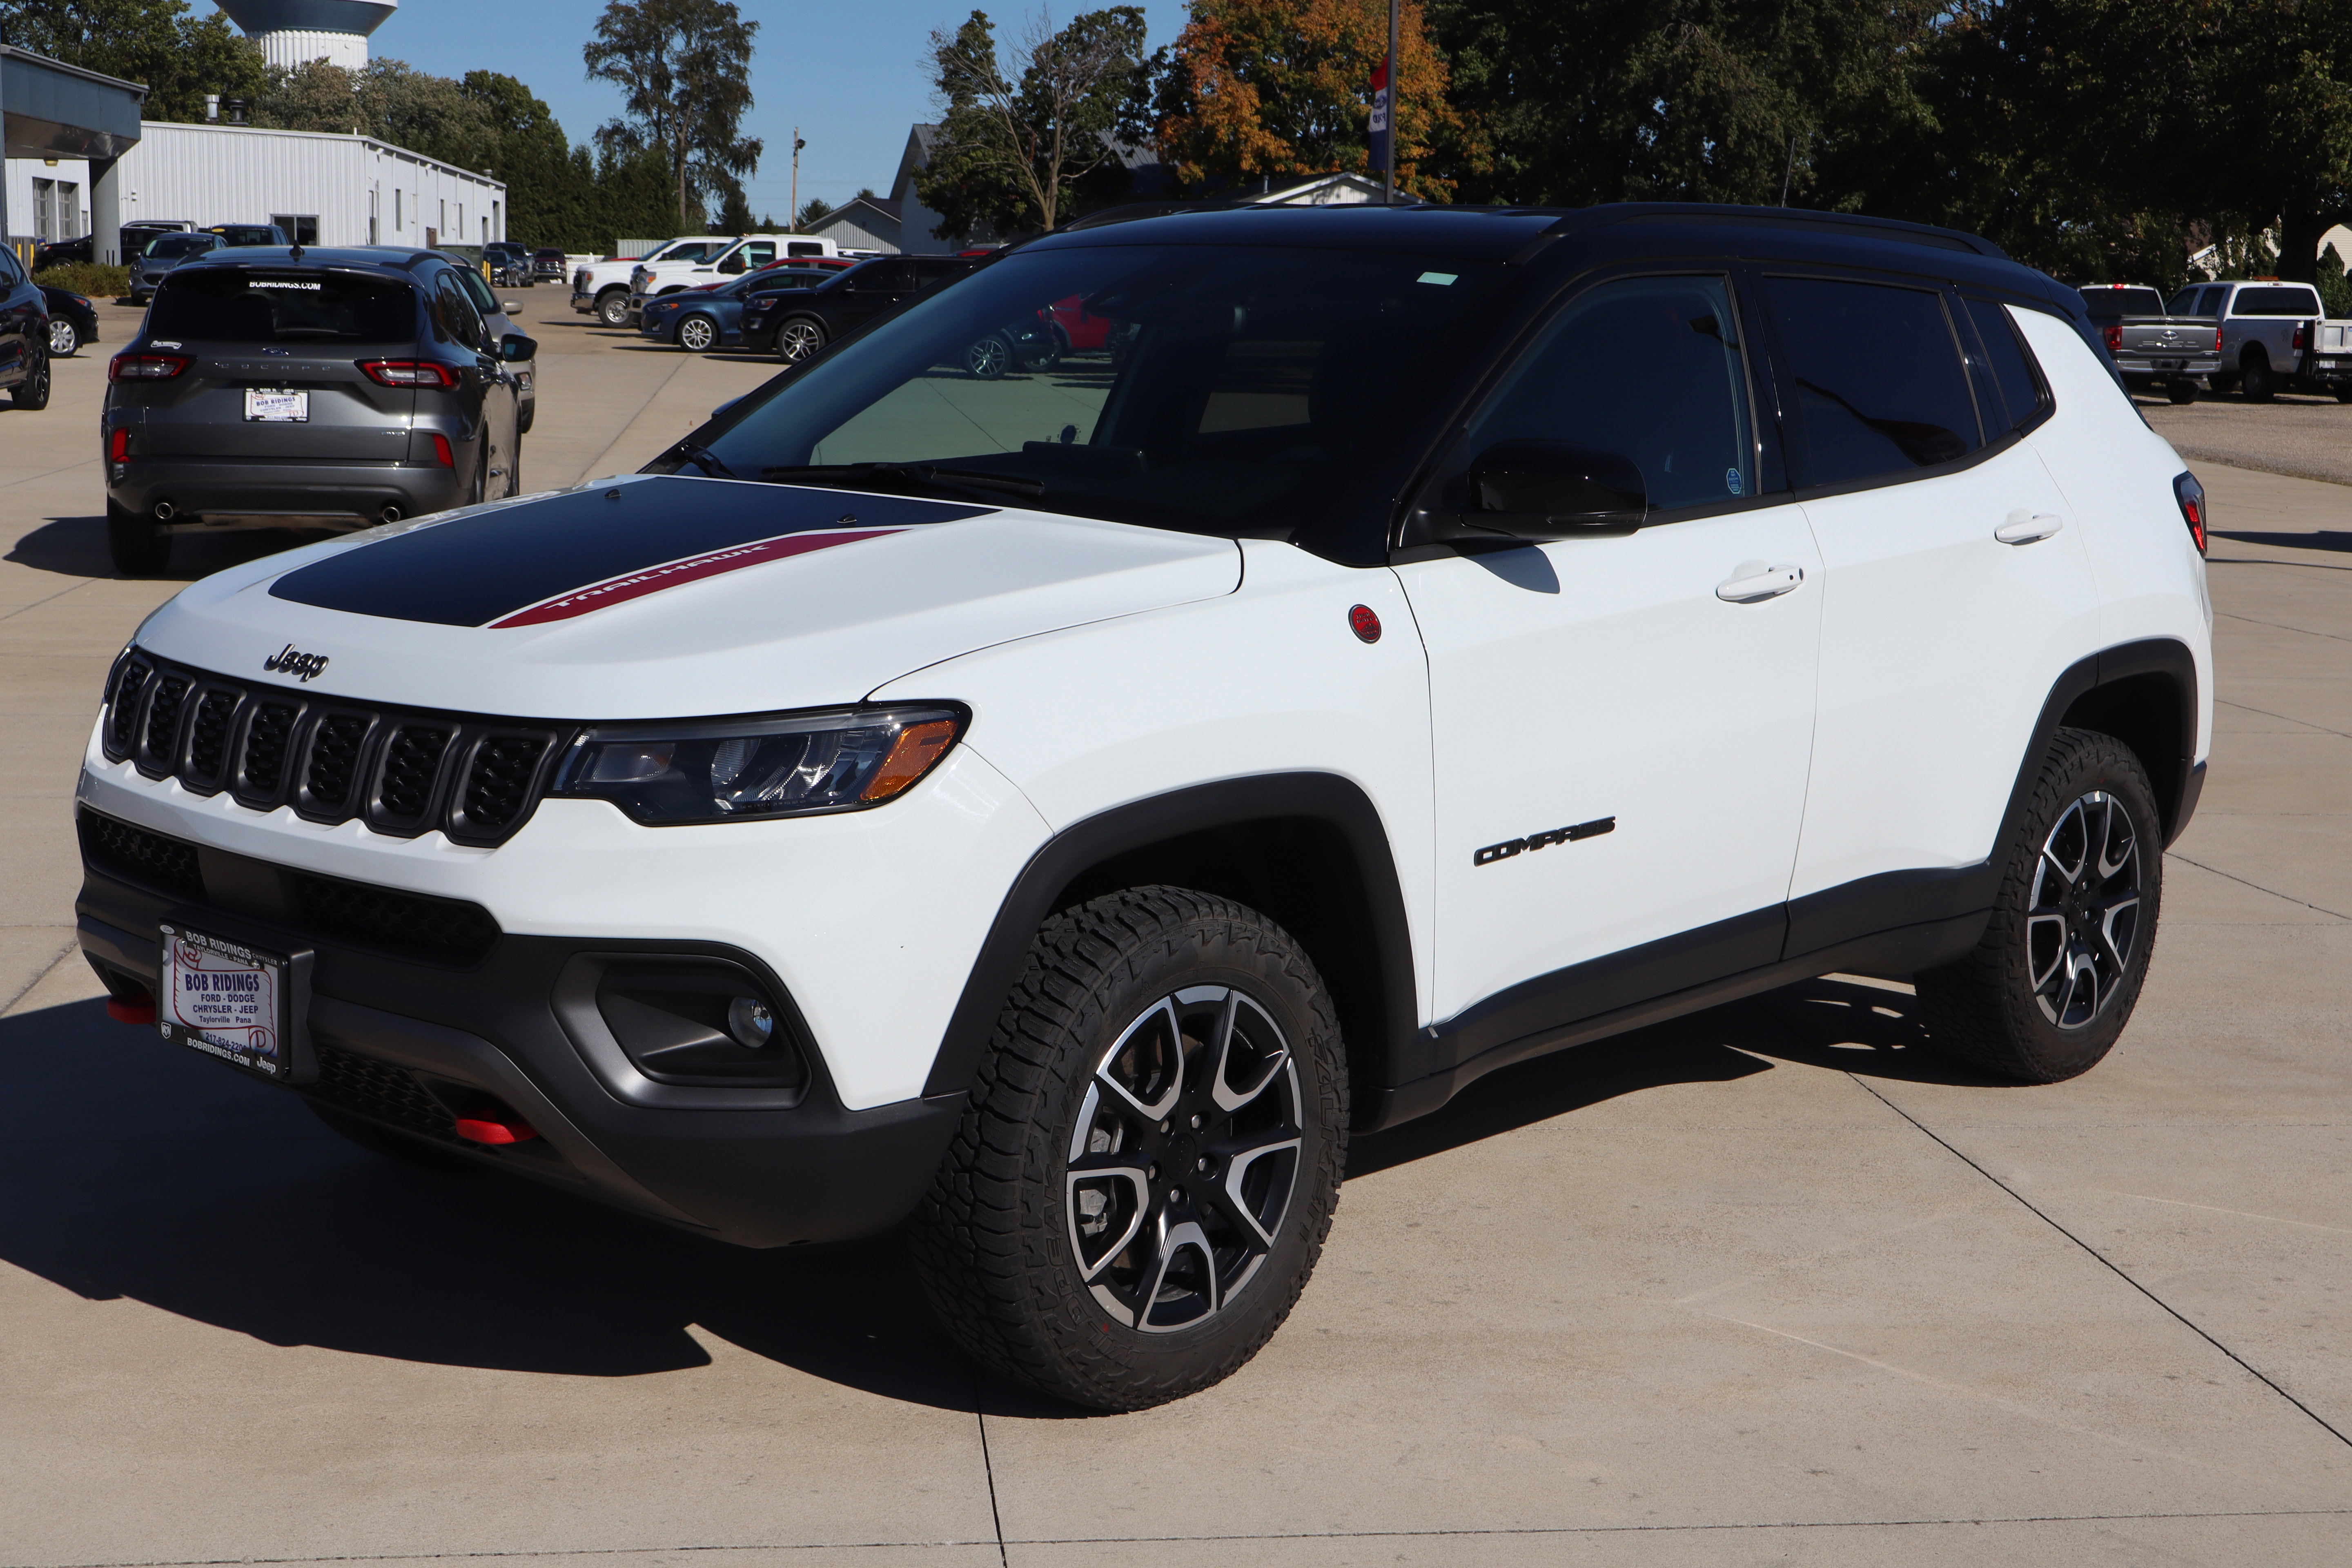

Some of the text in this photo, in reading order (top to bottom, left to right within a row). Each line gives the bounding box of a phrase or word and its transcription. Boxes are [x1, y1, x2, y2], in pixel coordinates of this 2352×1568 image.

[249, 281, 321, 290] BOBRIDINGS.COM
[271, 396, 296, 404] RIDINGS
[543, 545, 770, 610] TRAILHAWK
[265, 644, 330, 683] Jeep
[1473, 815, 1616, 867] COMPASS
[185, 931, 252, 960] BOB RIDINGS
[193, 944, 229, 960] TAYLORVILLE
[233, 956, 249, 966] PANA
[252, 953, 278, 966] CHRYSLER
[185, 973, 260, 992] BOB RIDINGS
[201, 994, 221, 1002] FORD
[227, 993, 255, 1003] DODGE
[193, 1004, 232, 1013] CHRYSLER
[239, 1005, 258, 1014] JEEP
[199, 1016, 230, 1024] Taylorville
[187, 1037, 250, 1067] BOBRIDINGS.COM
[256, 1056, 276, 1074] Jeep
